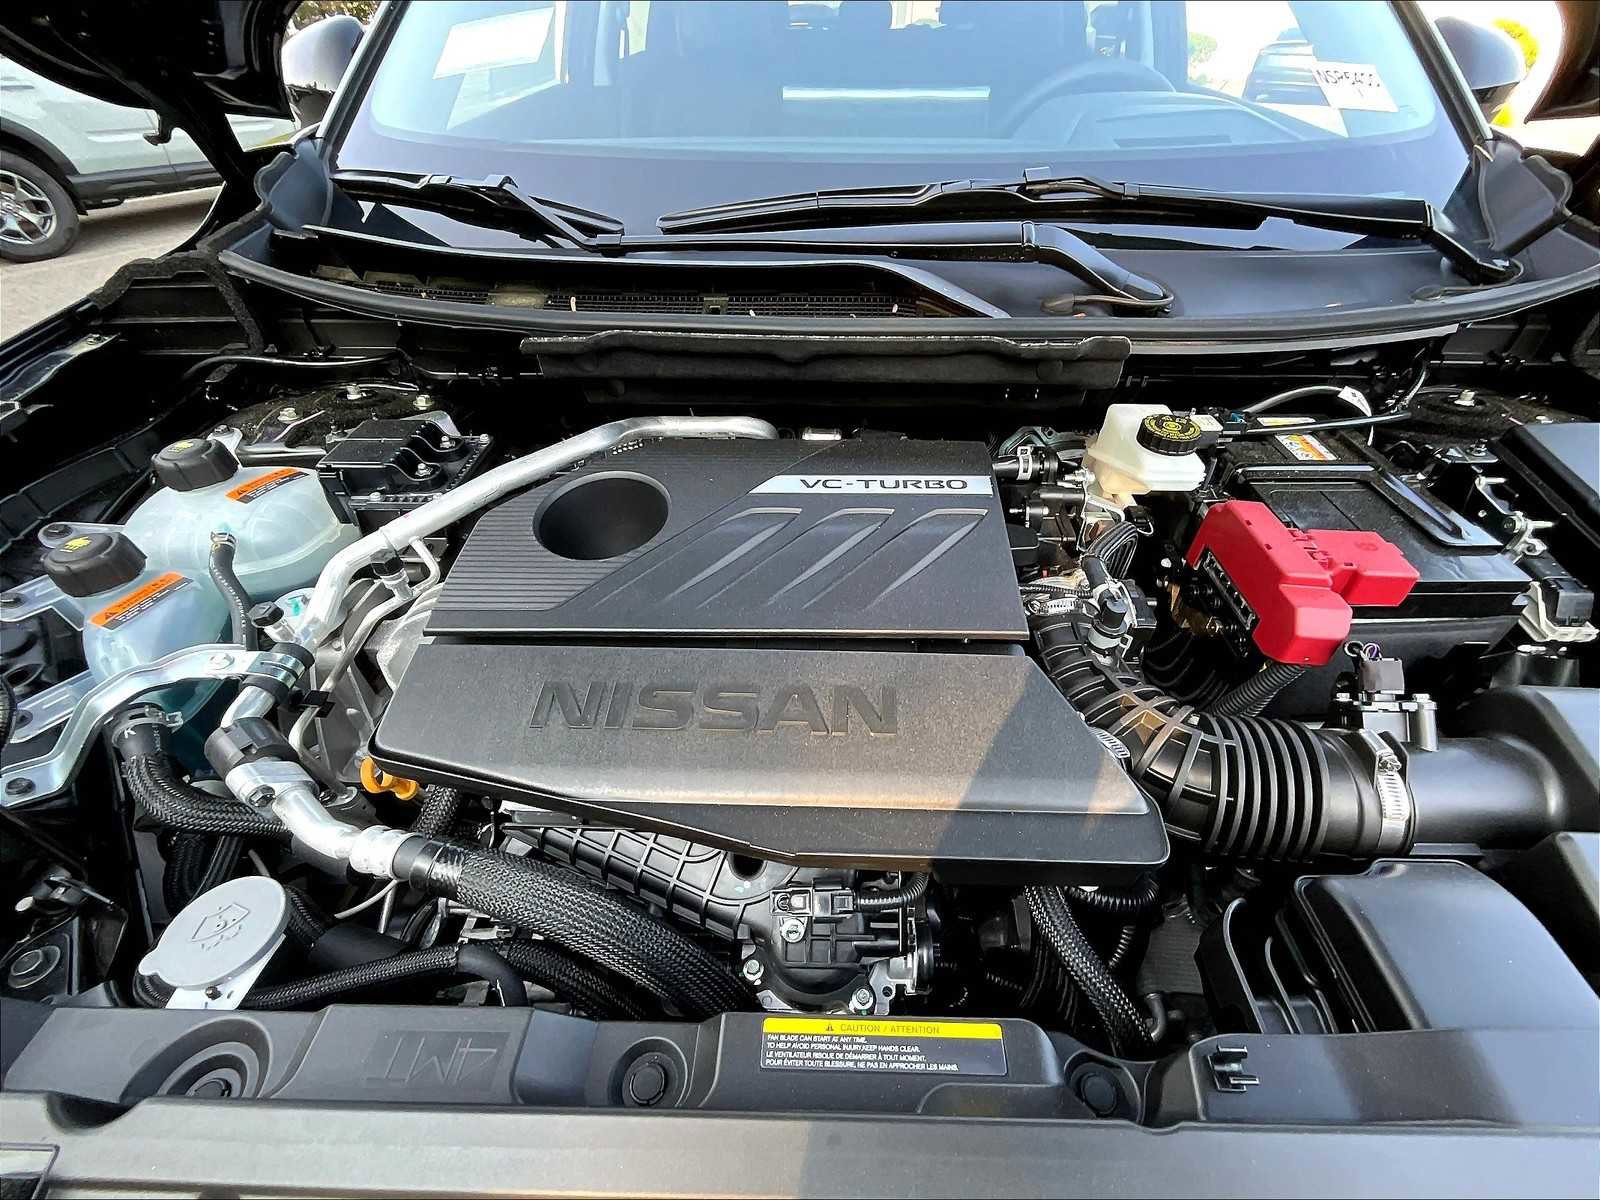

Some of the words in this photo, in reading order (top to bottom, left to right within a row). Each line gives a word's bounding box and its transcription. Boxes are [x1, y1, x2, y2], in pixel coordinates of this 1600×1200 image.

[799, 479, 969, 490] VC-TURBO
[529, 680, 898, 736] NISSAN
[840, 1023, 881, 1033] CAUTION
[890, 1025, 940, 1035] ATTENTION
[780, 1034, 799, 1042] BLADE
[813, 1035, 831, 1043] START
[792, 1042, 810, 1050] AVOID
[810, 1043, 842, 1051] PERSONAL
[878, 1044, 899, 1052] HANDS
[899, 1045, 921, 1053] CLEAR.
[766, 1050, 774, 1058] LE
[774, 1051, 813, 1059] VENTILATEUR
[812, 1052, 836, 1060] RISQUE
[835, 1052, 844, 1060] DE
[883, 1053, 900, 1061] TOUT
[899, 1054, 927, 1062] MOMENT.
[765, 1058, 783, 1066] POUR
[804, 1059, 824, 1067] TOUTE
[857, 1061, 866, 1069] NE
[866, 1061, 879, 1069] PAS
[879, 1062, 889, 1070] EN
[888, 1062, 926, 1070] APPROCHER
[937, 1063, 959, 1071] MAINS.
